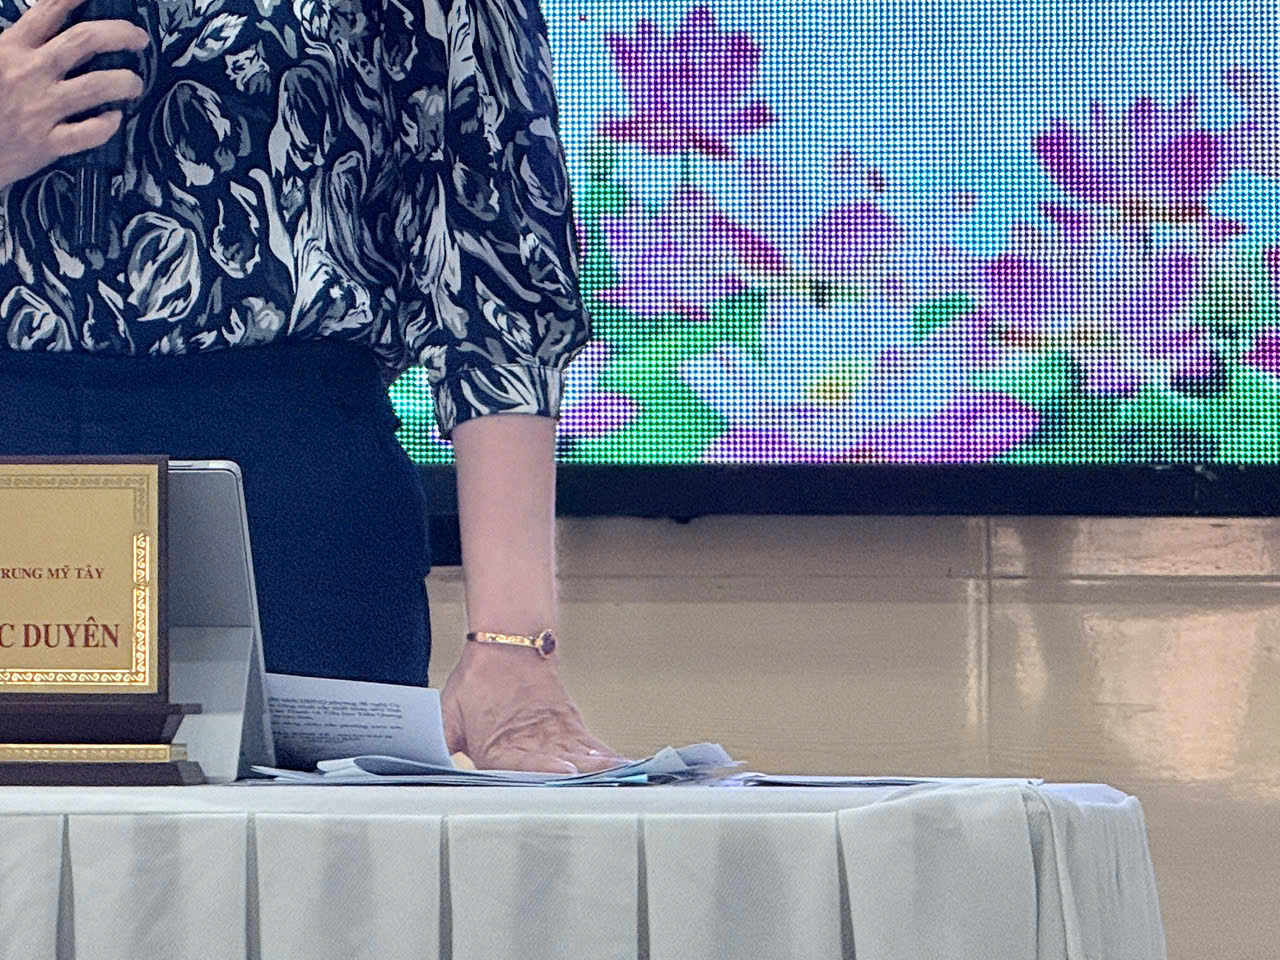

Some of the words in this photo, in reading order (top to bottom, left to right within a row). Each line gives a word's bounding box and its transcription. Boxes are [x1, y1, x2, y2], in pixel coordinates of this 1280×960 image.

[47, 565, 70, 579] MỸ
[75, 565, 104, 579] TÂY
[23, 616, 120, 648] DUYÊN
